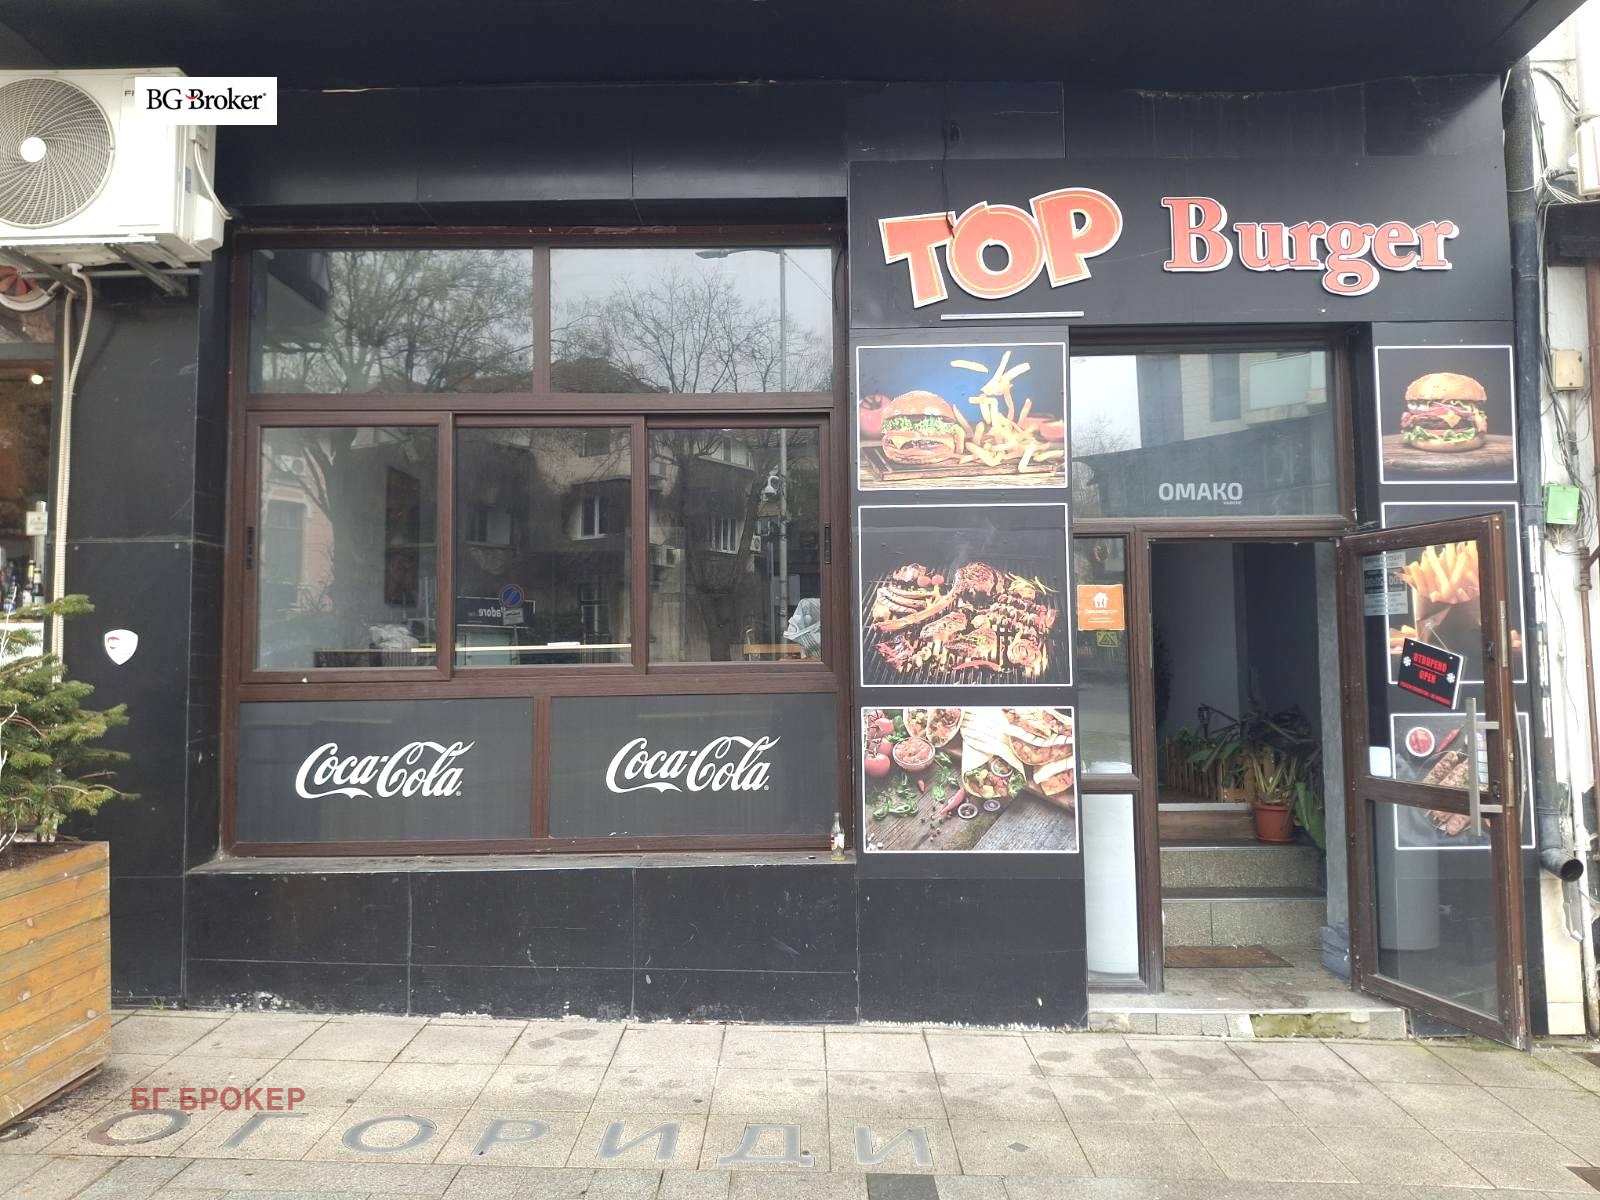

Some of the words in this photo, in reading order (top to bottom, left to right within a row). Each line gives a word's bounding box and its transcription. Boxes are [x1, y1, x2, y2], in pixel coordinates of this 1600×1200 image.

[879, 187, 1124, 309] TOP
[1161, 195, 1460, 298] Burger
[1158, 482, 1244, 501] OMAKO
[1418, 670, 1437, 685] OPEN
[295, 740, 475, 800] Coca-Cola
[605, 735, 781, 795] Coca-Cola
